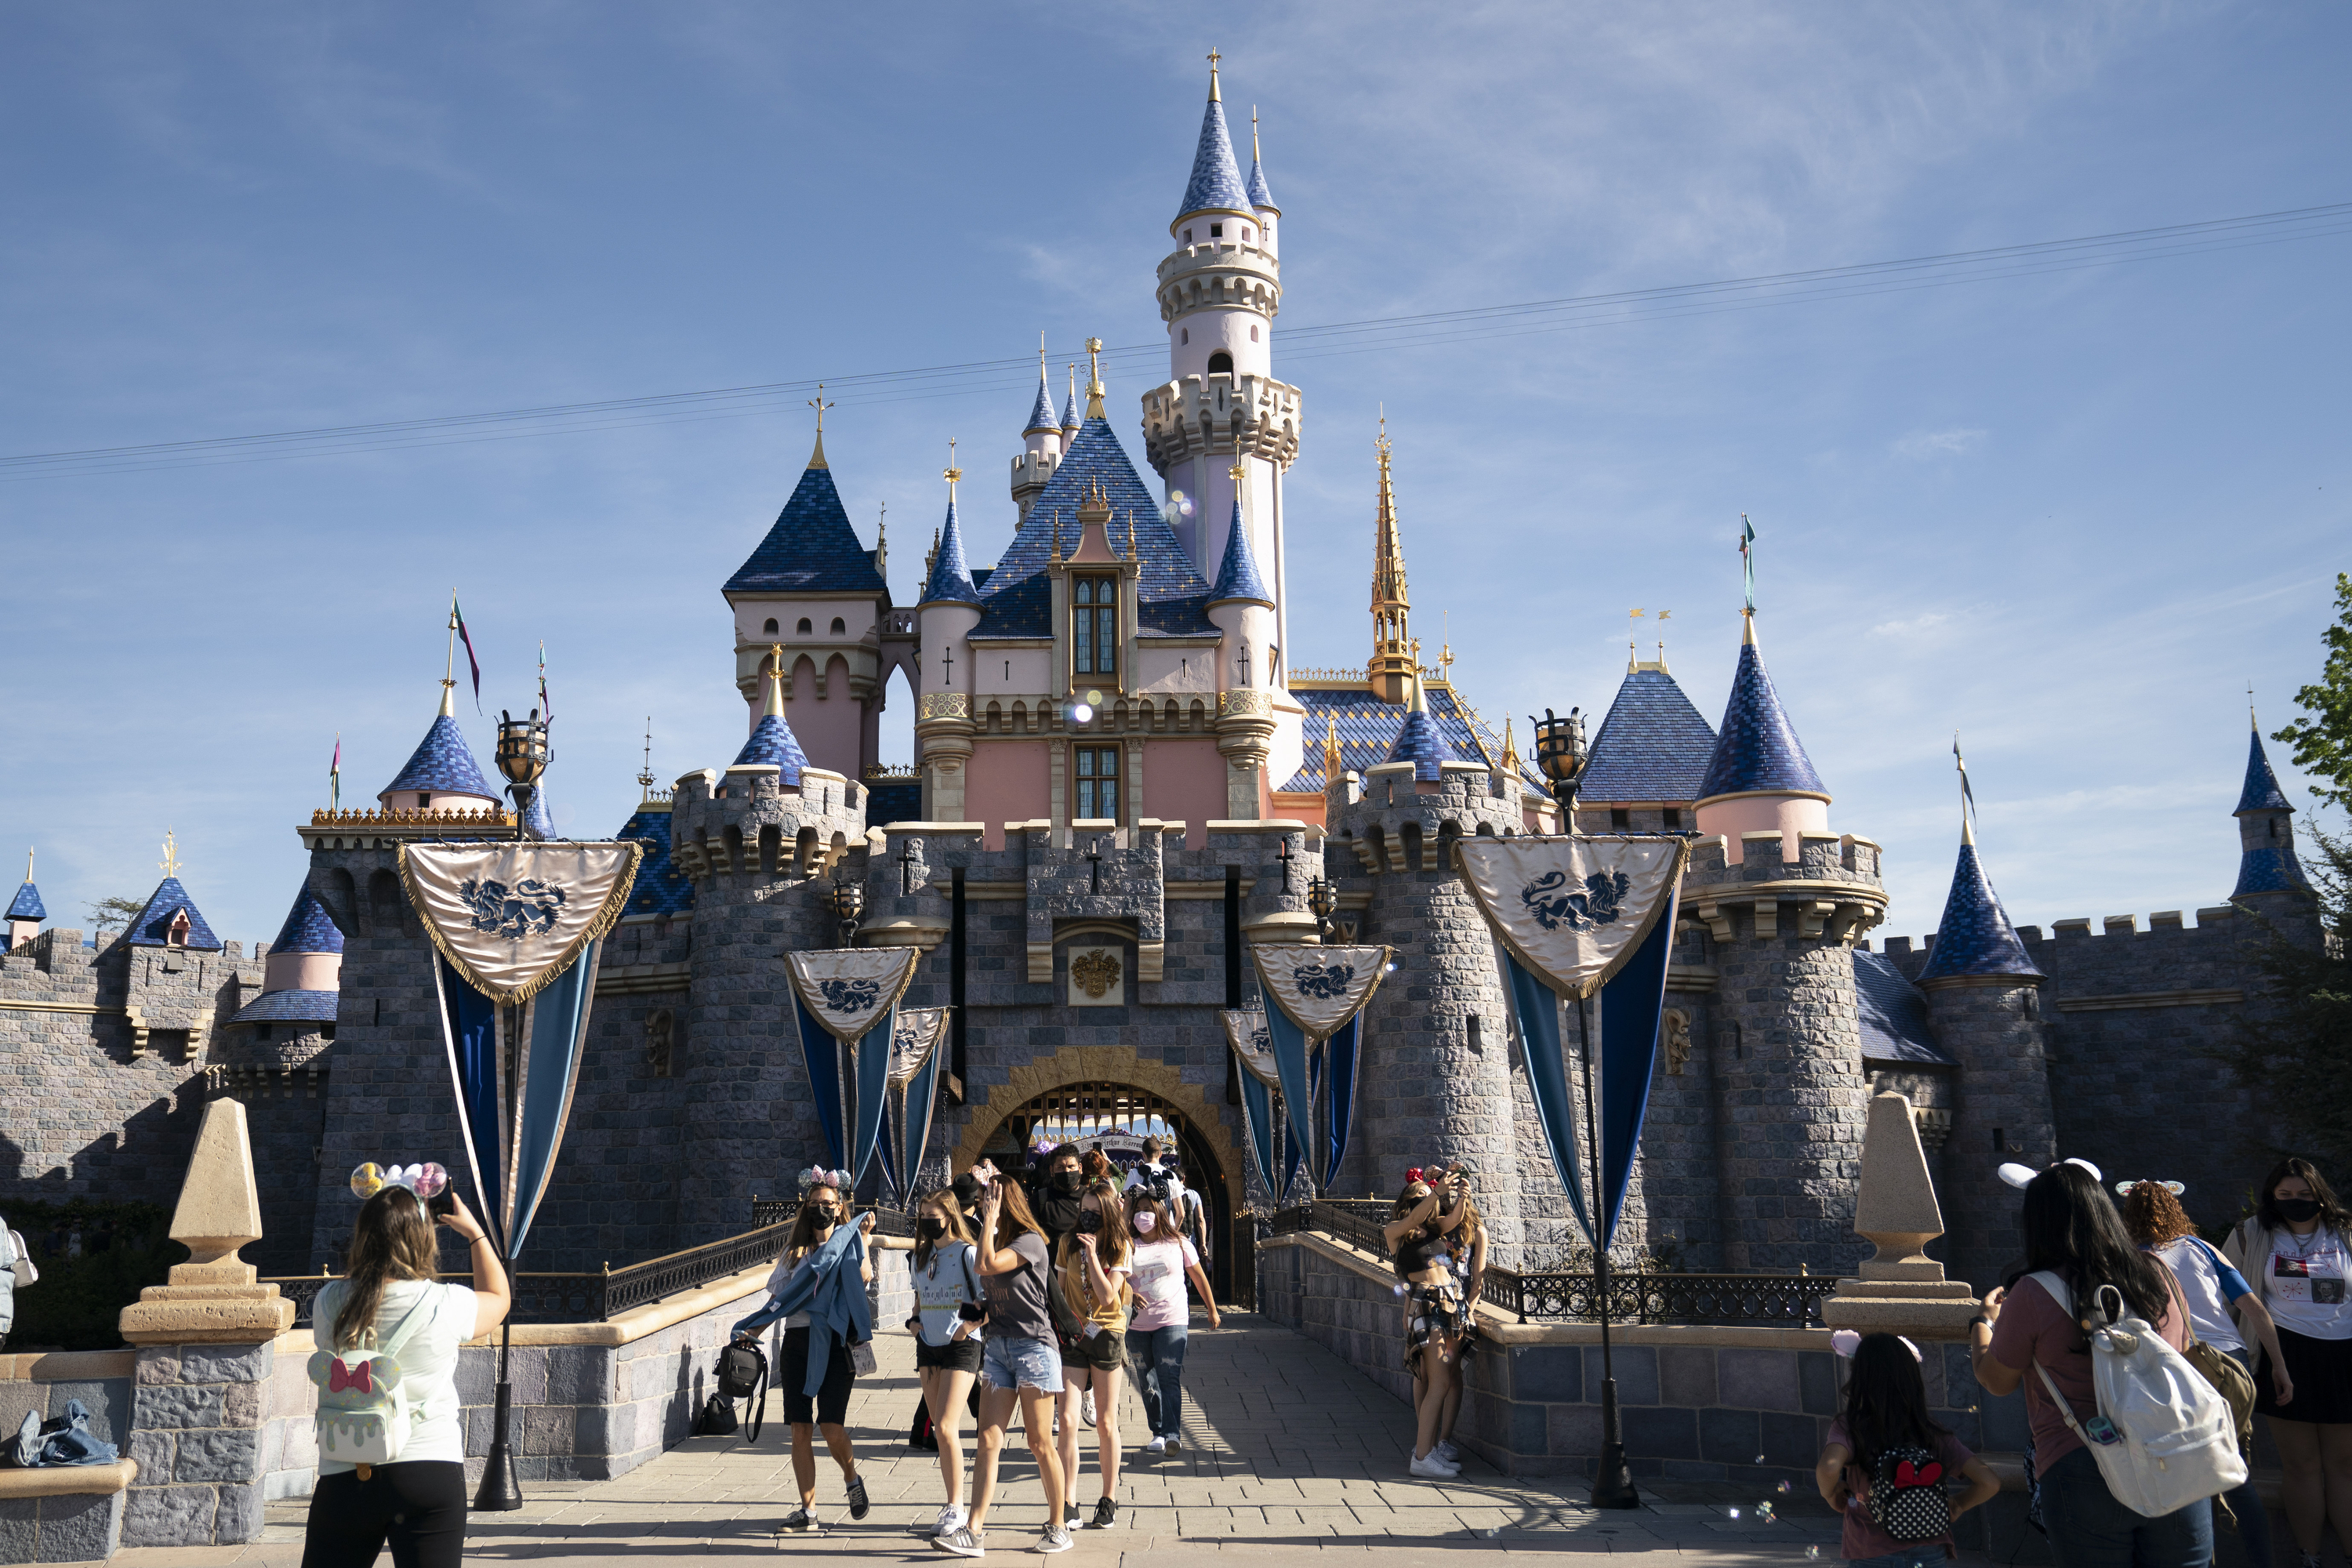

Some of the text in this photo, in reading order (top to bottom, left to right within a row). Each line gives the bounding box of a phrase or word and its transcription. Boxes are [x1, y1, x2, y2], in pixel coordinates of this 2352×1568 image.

[1080, 1136, 1143, 1151] Kin Arthur Carrou
[922, 1287, 962, 1301] sneyland
